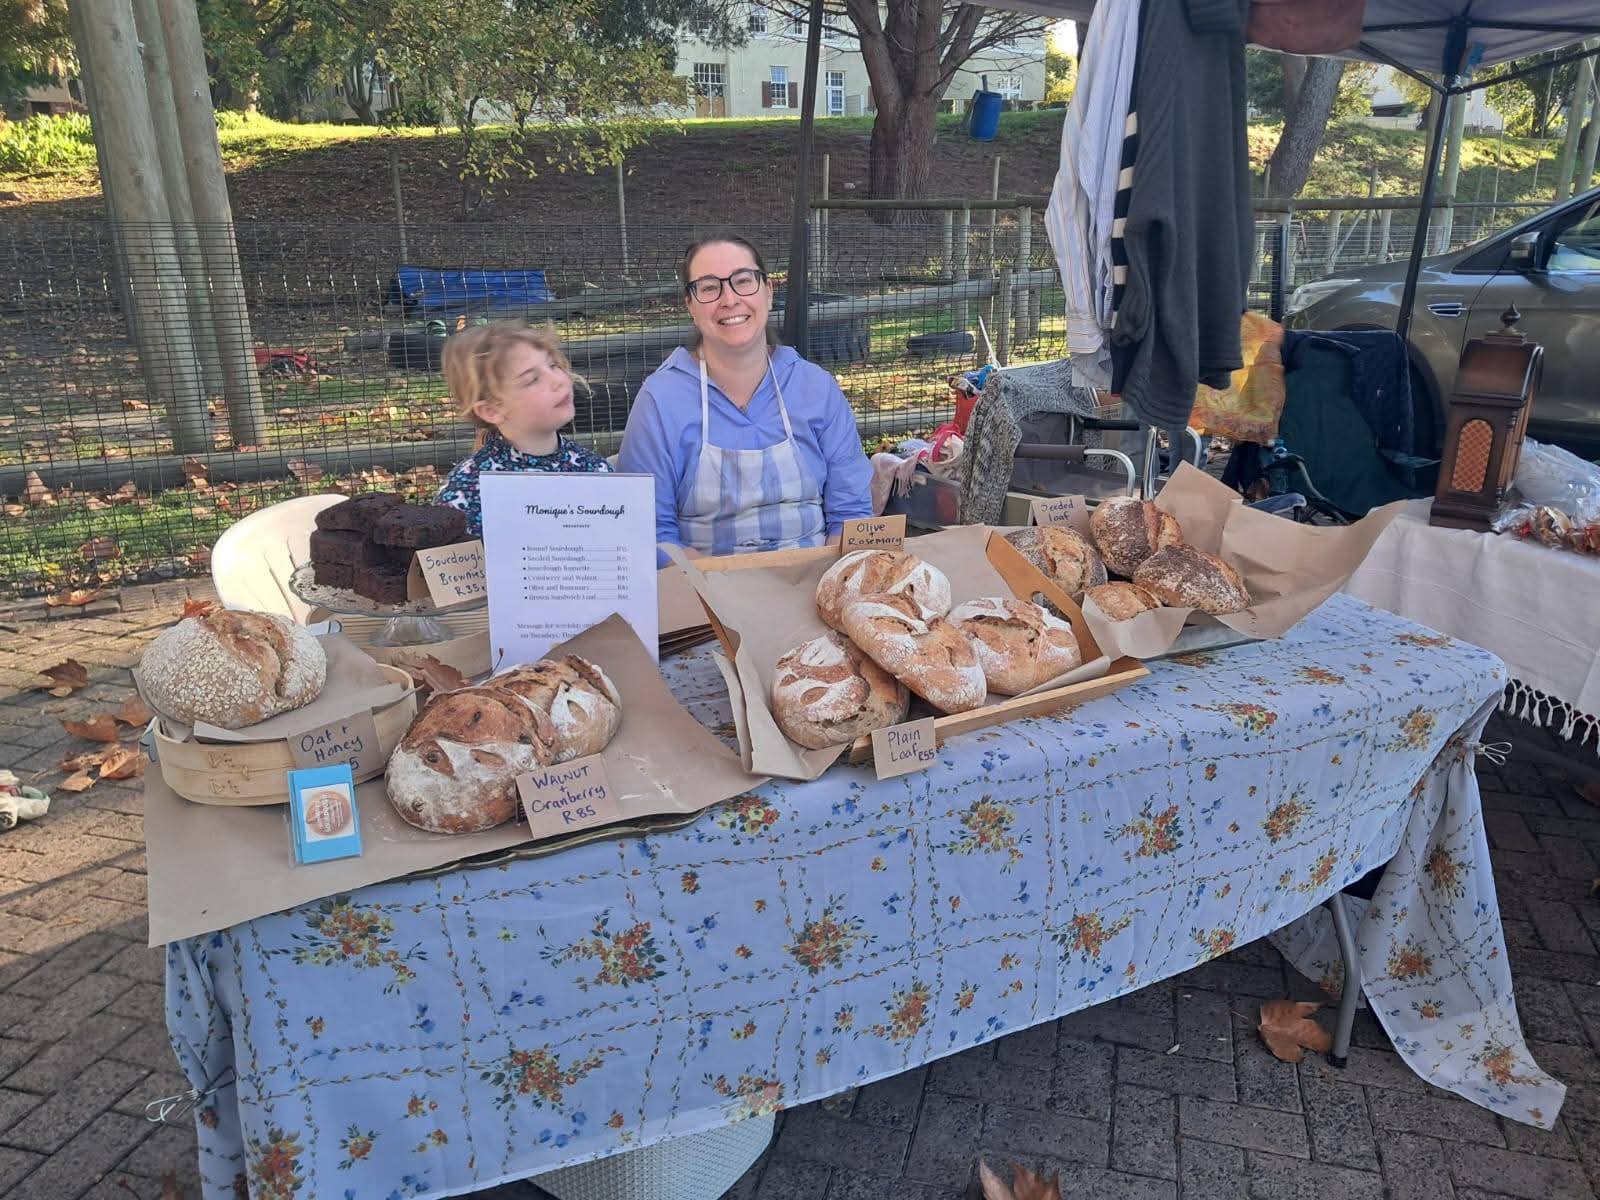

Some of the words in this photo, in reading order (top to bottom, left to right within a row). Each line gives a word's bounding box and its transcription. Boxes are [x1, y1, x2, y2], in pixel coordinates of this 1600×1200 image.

[525, 504, 574, 518] Monique's
[576, 504, 625, 520] Sourdough
[856, 522, 886, 533] Olive
[426, 546, 483, 569] Sourdough
[439, 570, 486, 586] Brownies
[301, 730, 332, 752] Oat
[888, 729, 920, 748] Plain
[314, 736, 364, 762] Honey
[891, 742, 918, 762] Loaf
[532, 766, 589, 789] WALNUT
[532, 785, 606, 813] Cranberry
[562, 804, 596, 824] R85
